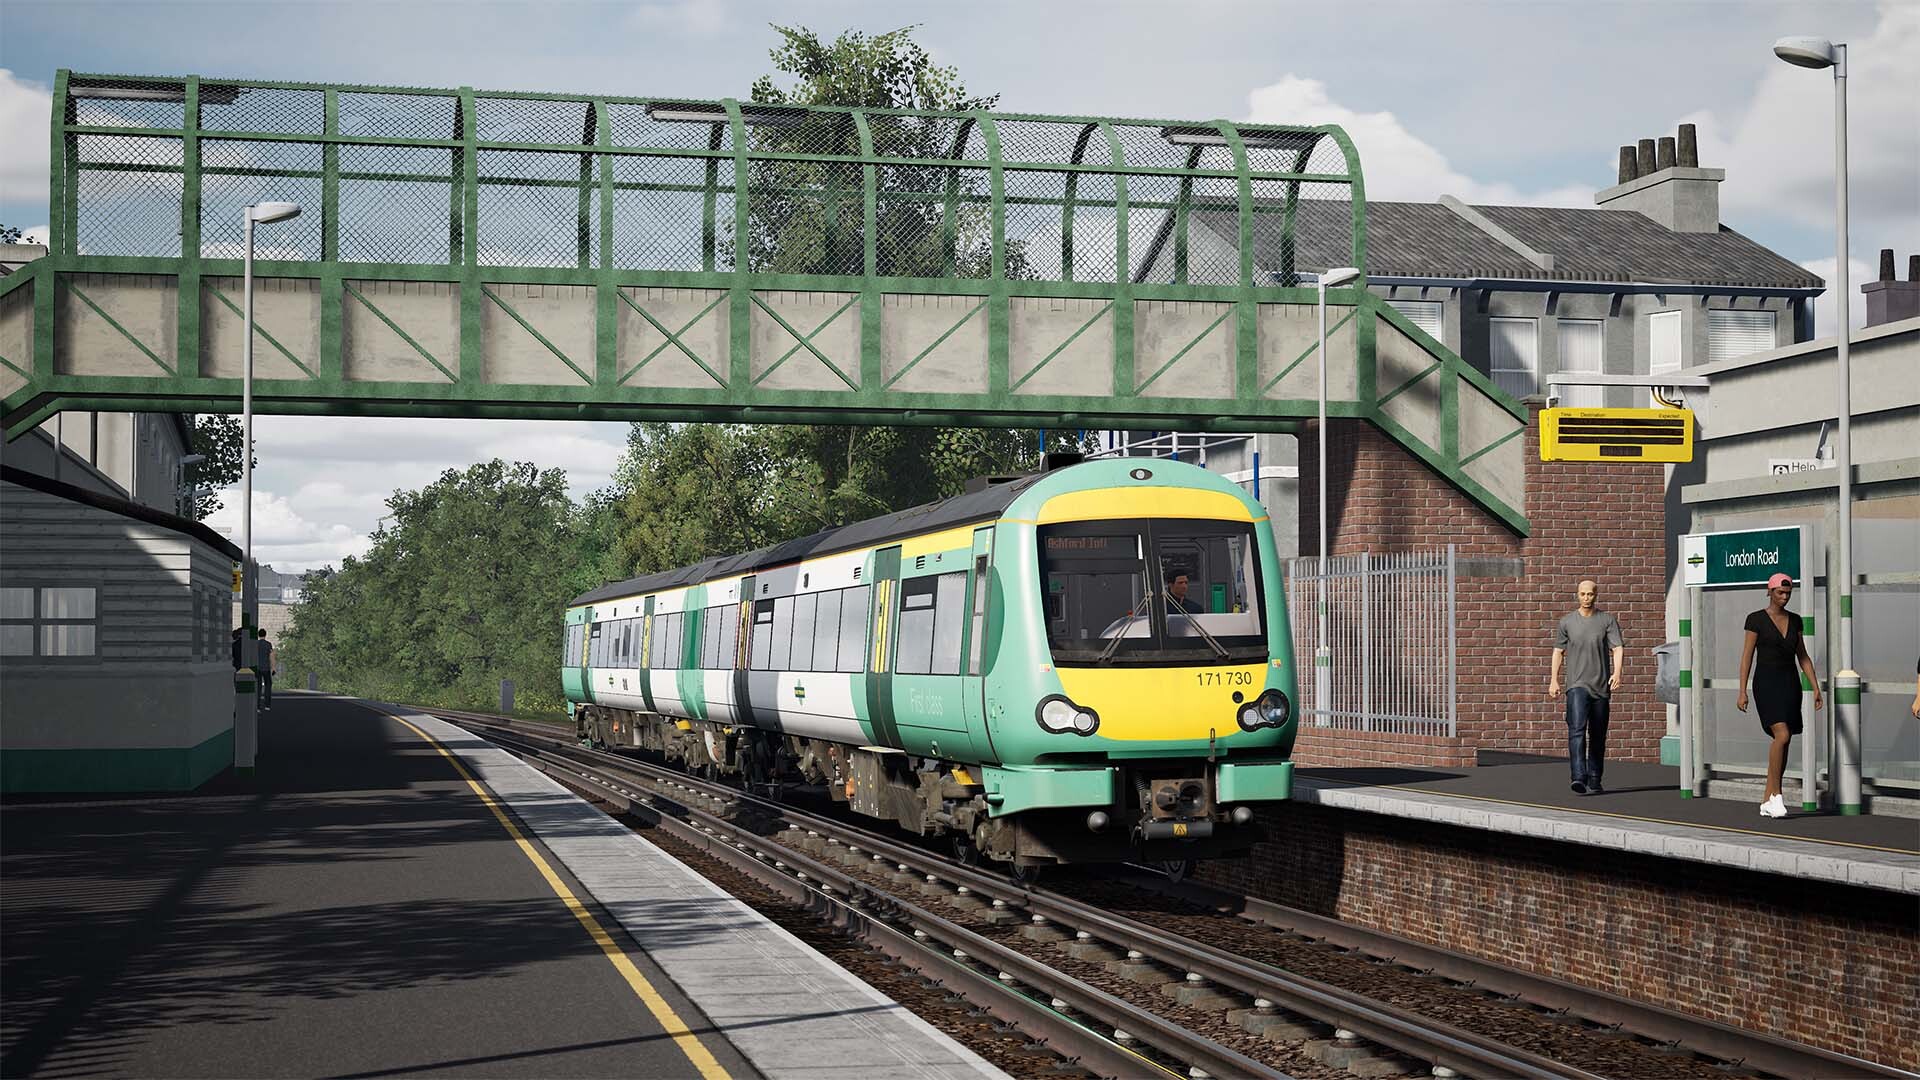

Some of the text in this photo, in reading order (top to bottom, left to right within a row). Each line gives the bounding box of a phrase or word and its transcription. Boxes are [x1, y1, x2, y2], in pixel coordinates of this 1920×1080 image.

[1725, 546, 1779, 567] London Road
[1197, 671, 1252, 686] 171 730
